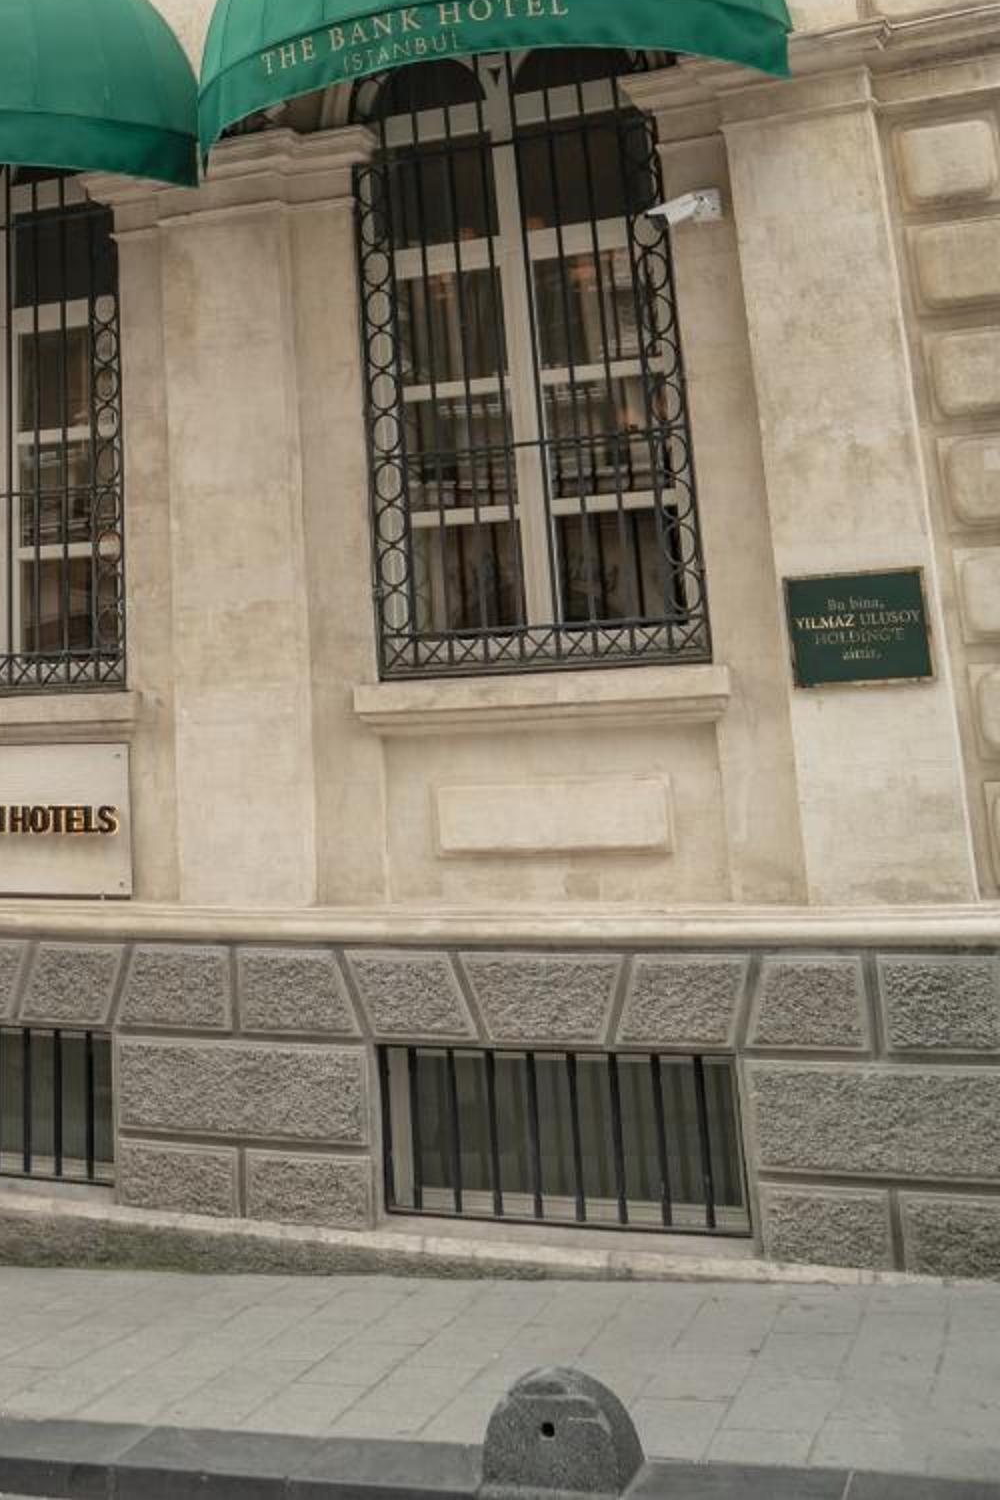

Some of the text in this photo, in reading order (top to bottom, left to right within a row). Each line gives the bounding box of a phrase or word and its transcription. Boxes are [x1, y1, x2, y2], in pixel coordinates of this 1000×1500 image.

[261, 37, 317, 76] THE
[328, 6, 422, 49] BANK
[795, 609, 921, 629] YILMAZ ULUSOY
[10, 804, 118, 834] HOTELS
